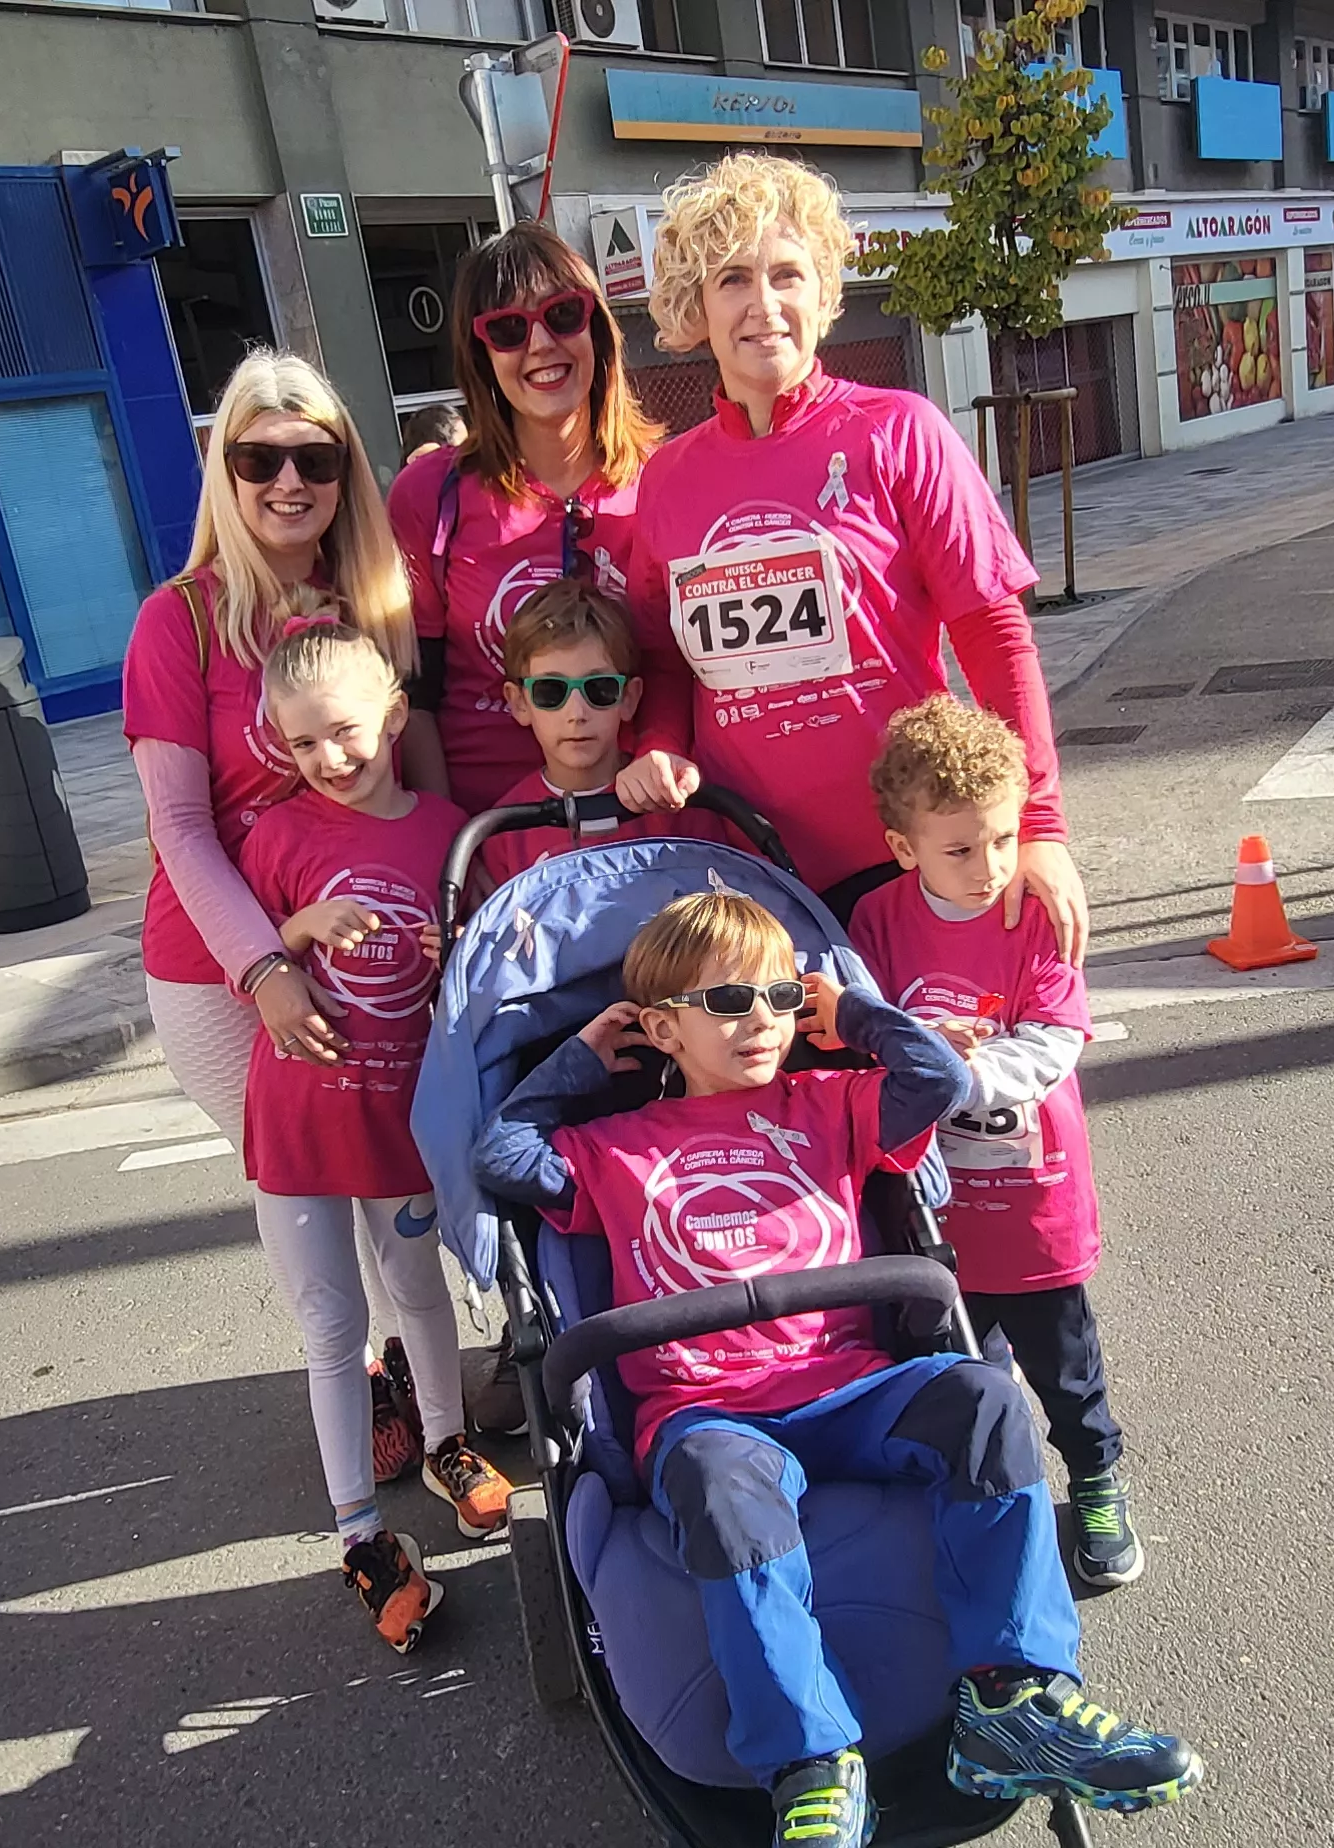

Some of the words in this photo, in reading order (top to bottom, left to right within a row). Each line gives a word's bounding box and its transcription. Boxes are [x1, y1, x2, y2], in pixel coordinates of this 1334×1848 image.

[1186, 208, 1271, 239] ALTOARAGÓN
[725, 562, 765, 578] HUESCA
[685, 580, 737, 598] CONTRA
[739, 576, 755, 589] EL
[757, 566, 816, 587] CÁNCER
[688, 588, 826, 652] 1524
[684, 1159, 716, 1170] CONTRA
[718, 1157, 728, 1165] EL
[685, 1210, 758, 1230] Caminemos
[694, 1227, 756, 1250] JUNTOS
